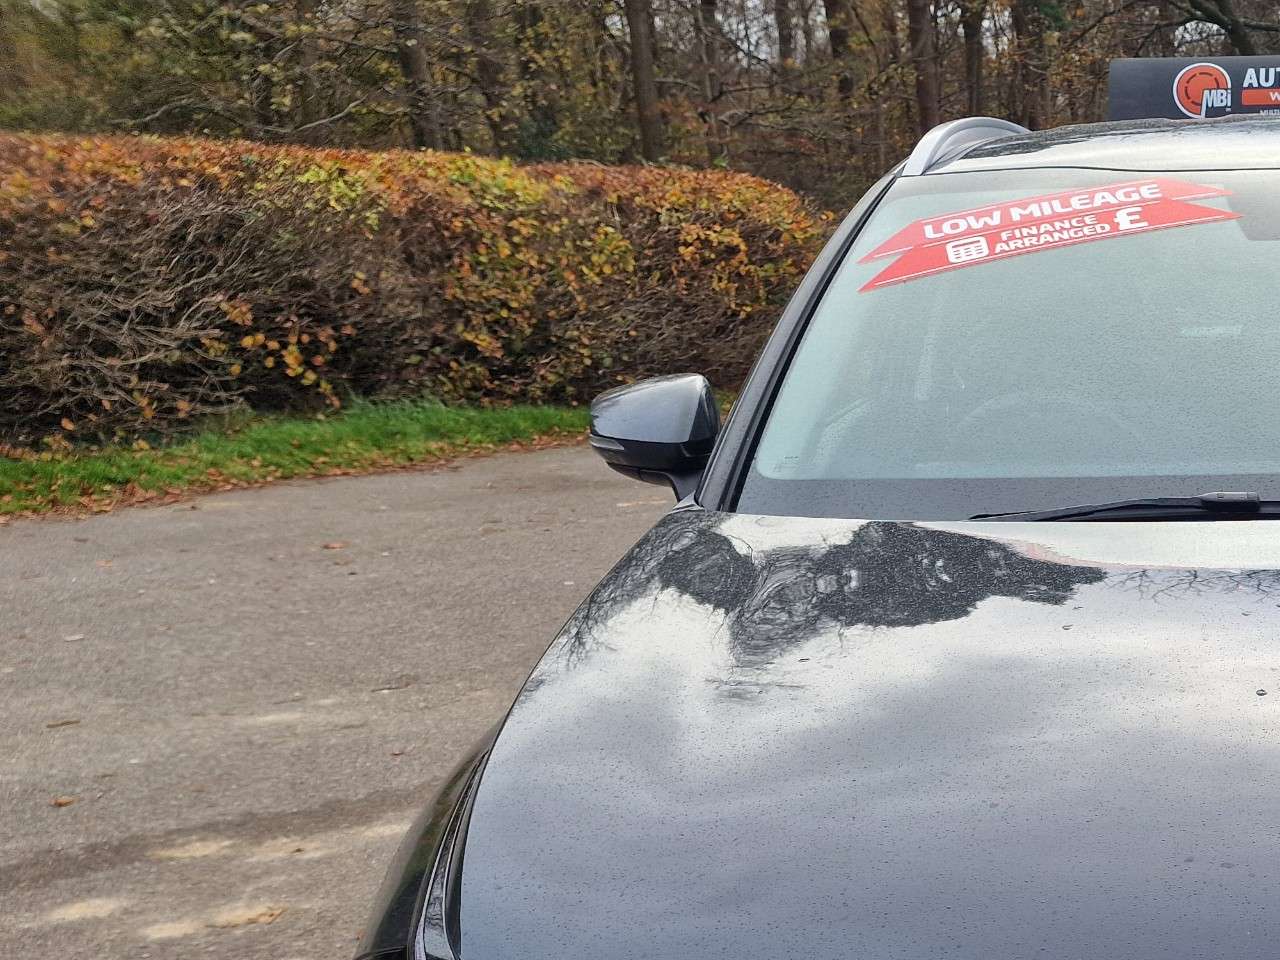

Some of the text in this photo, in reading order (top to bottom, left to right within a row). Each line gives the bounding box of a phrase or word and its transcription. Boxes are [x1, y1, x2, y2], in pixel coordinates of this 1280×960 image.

[923, 184, 1161, 240] LOW MILEAGE
[1114, 206, 1148, 231] £
[994, 223, 1111, 253] ARRANGED
[1000, 214, 1097, 241] FINANCE
